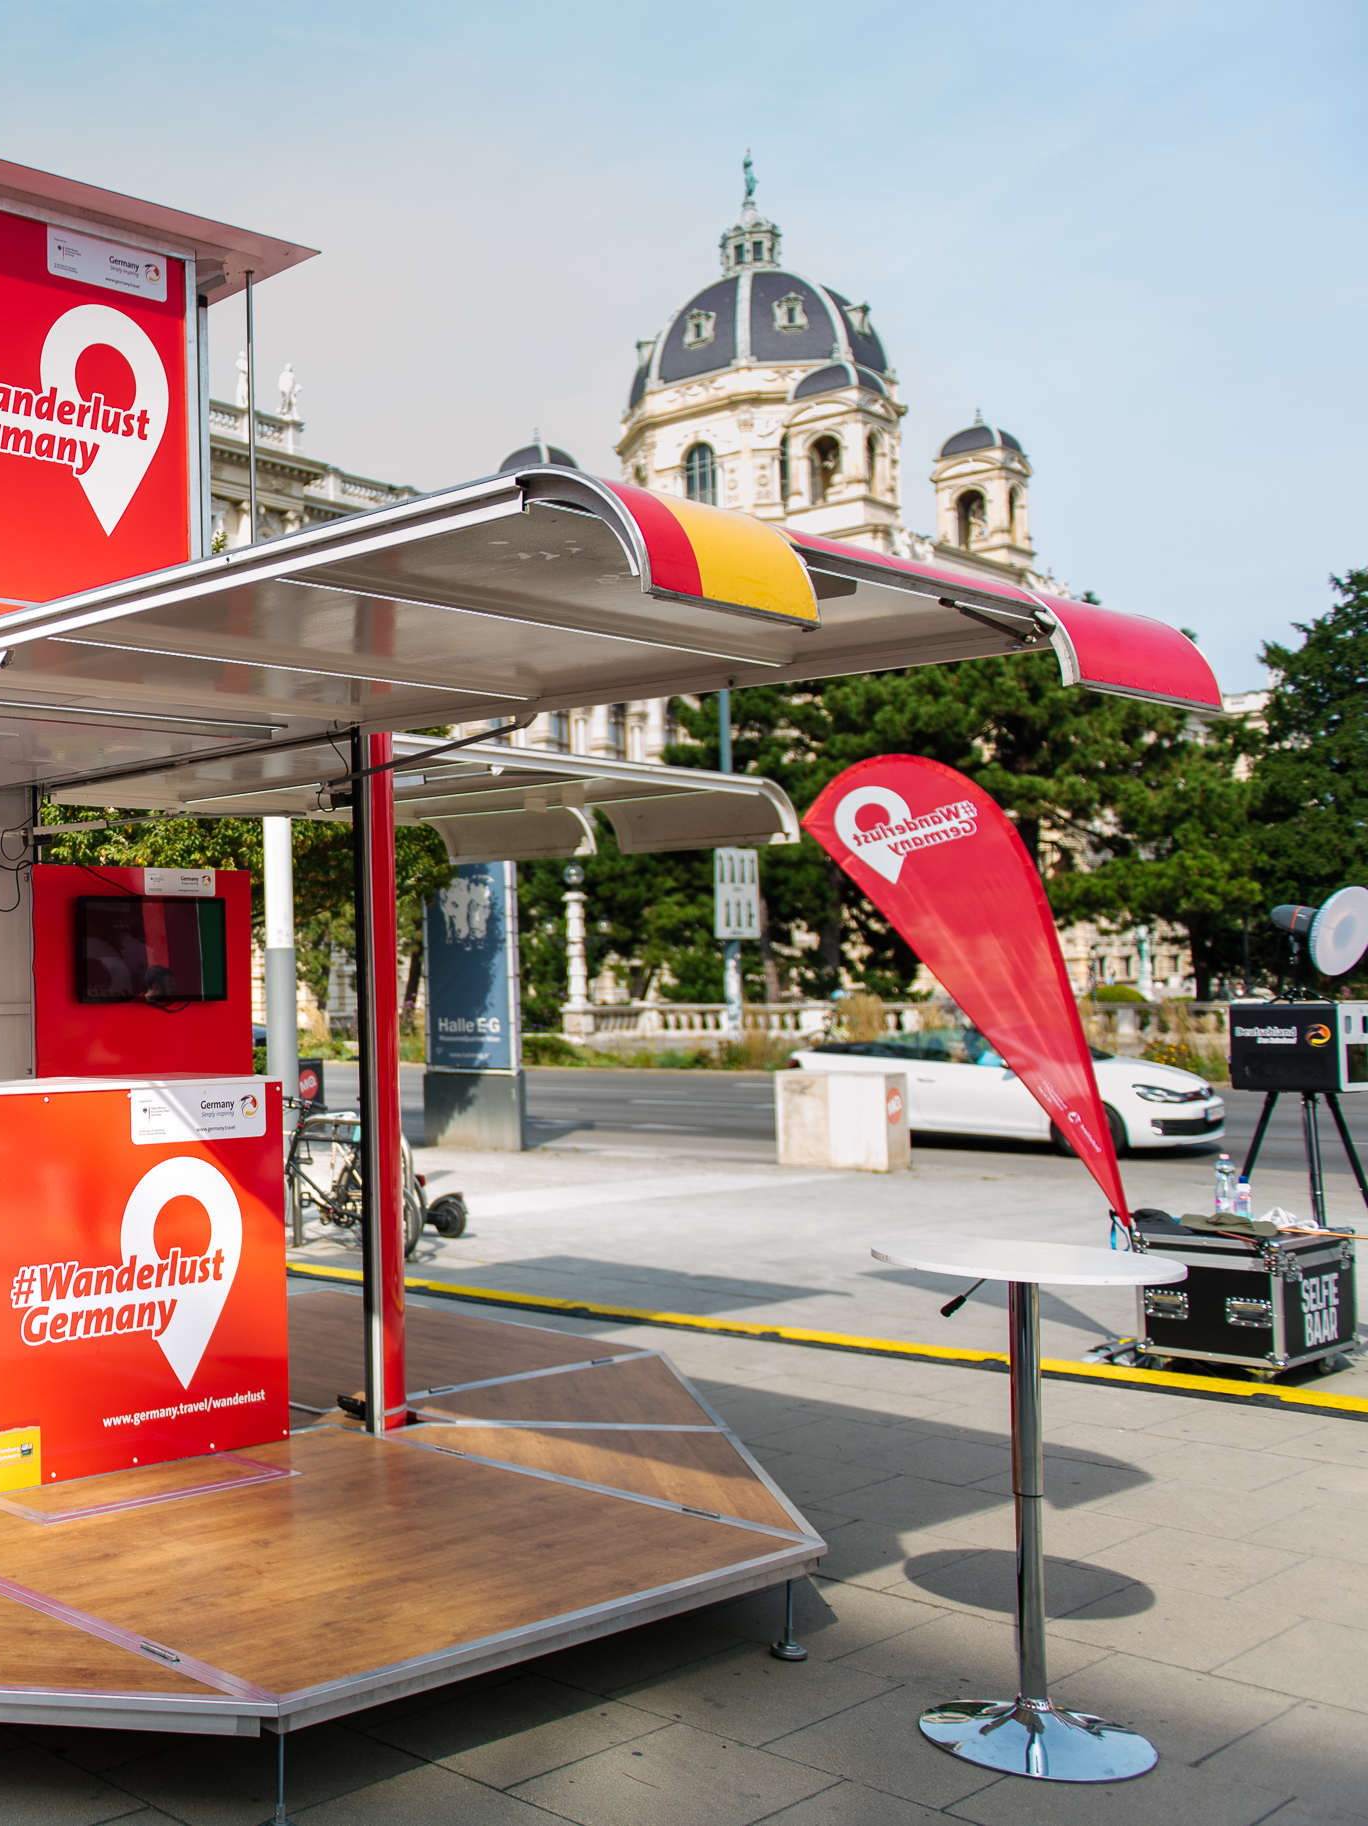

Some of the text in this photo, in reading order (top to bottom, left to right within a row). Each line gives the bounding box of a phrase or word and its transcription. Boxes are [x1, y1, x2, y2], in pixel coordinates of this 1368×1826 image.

[109, 255, 139, 272] Germany
[438, 1017, 474, 1032] Halle
[1234, 1026, 1297, 1037] Deutschland
[299, 1075, 317, 1093] MQ
[200, 1100, 234, 1110] Germany
[216, 1110, 234, 1118] inspiring
[13, 1248, 224, 1306] #Wanderlust
[1301, 1272, 1339, 1313] SELFIE
[23, 1299, 178, 1343] Germany
[1304, 1306, 1338, 1347] BAAR
[102, 1389, 265, 1427] www.germany.travel/wanderlust
